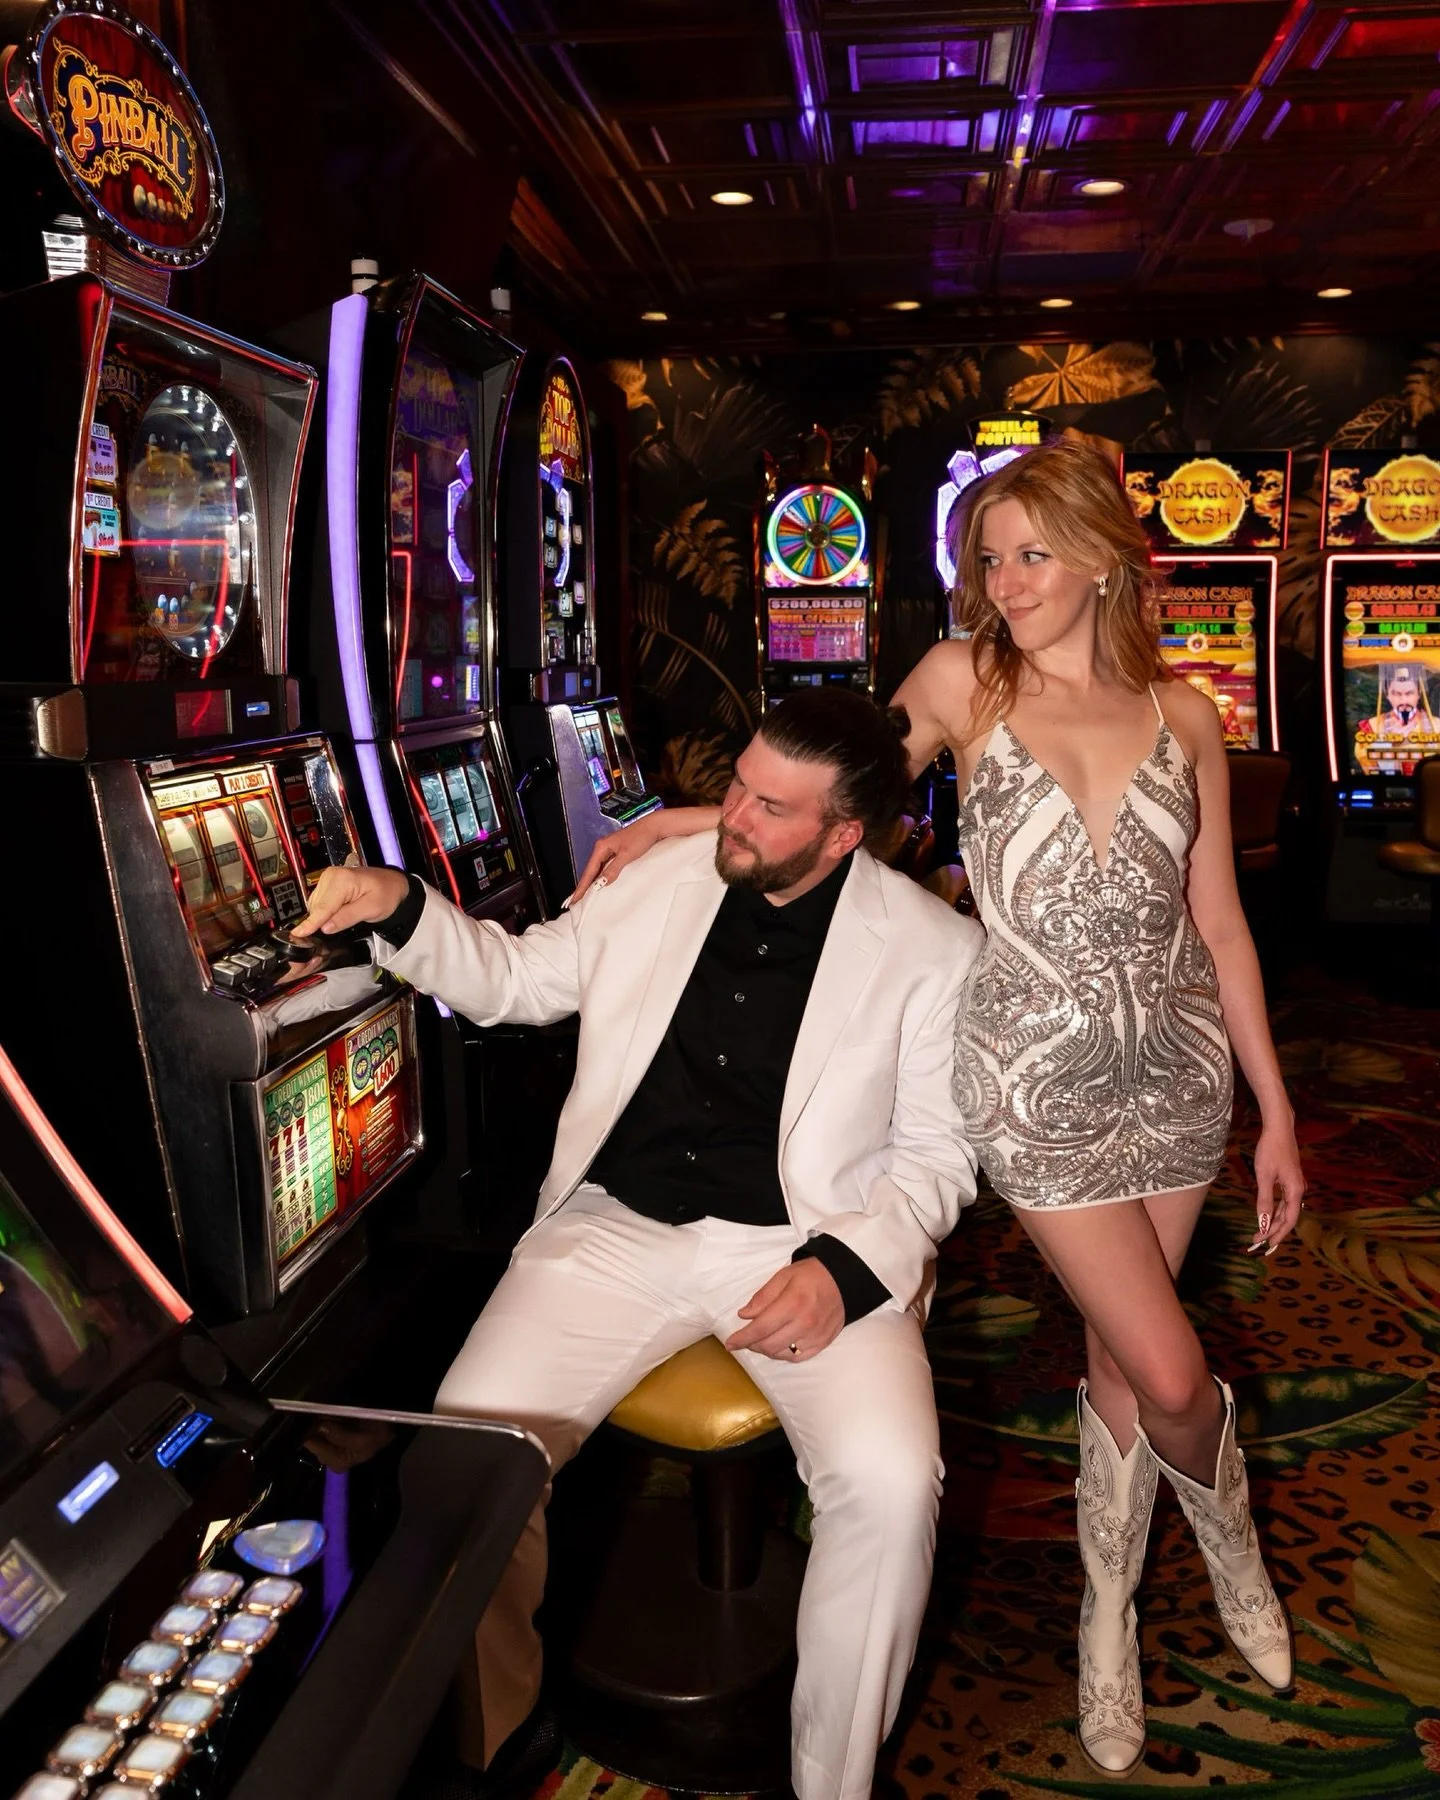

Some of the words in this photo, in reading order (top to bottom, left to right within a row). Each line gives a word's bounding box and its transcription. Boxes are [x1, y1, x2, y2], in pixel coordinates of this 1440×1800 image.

[68, 74, 186, 184] PINBALL
[552, 390, 571, 426] TOP
[976, 432, 1041, 446] FORTUNE
[1157, 479, 1251, 500] DRAGON
[1363, 478, 1440, 497] DRAGO
[1173, 506, 1232, 525] CASH
[1346, 586, 1414, 601] DRAGON
[771, 600, 863, 610] $200,000.00
[357, 1023, 377, 1048] CREDIT
[307, 1077, 328, 1107] 800
